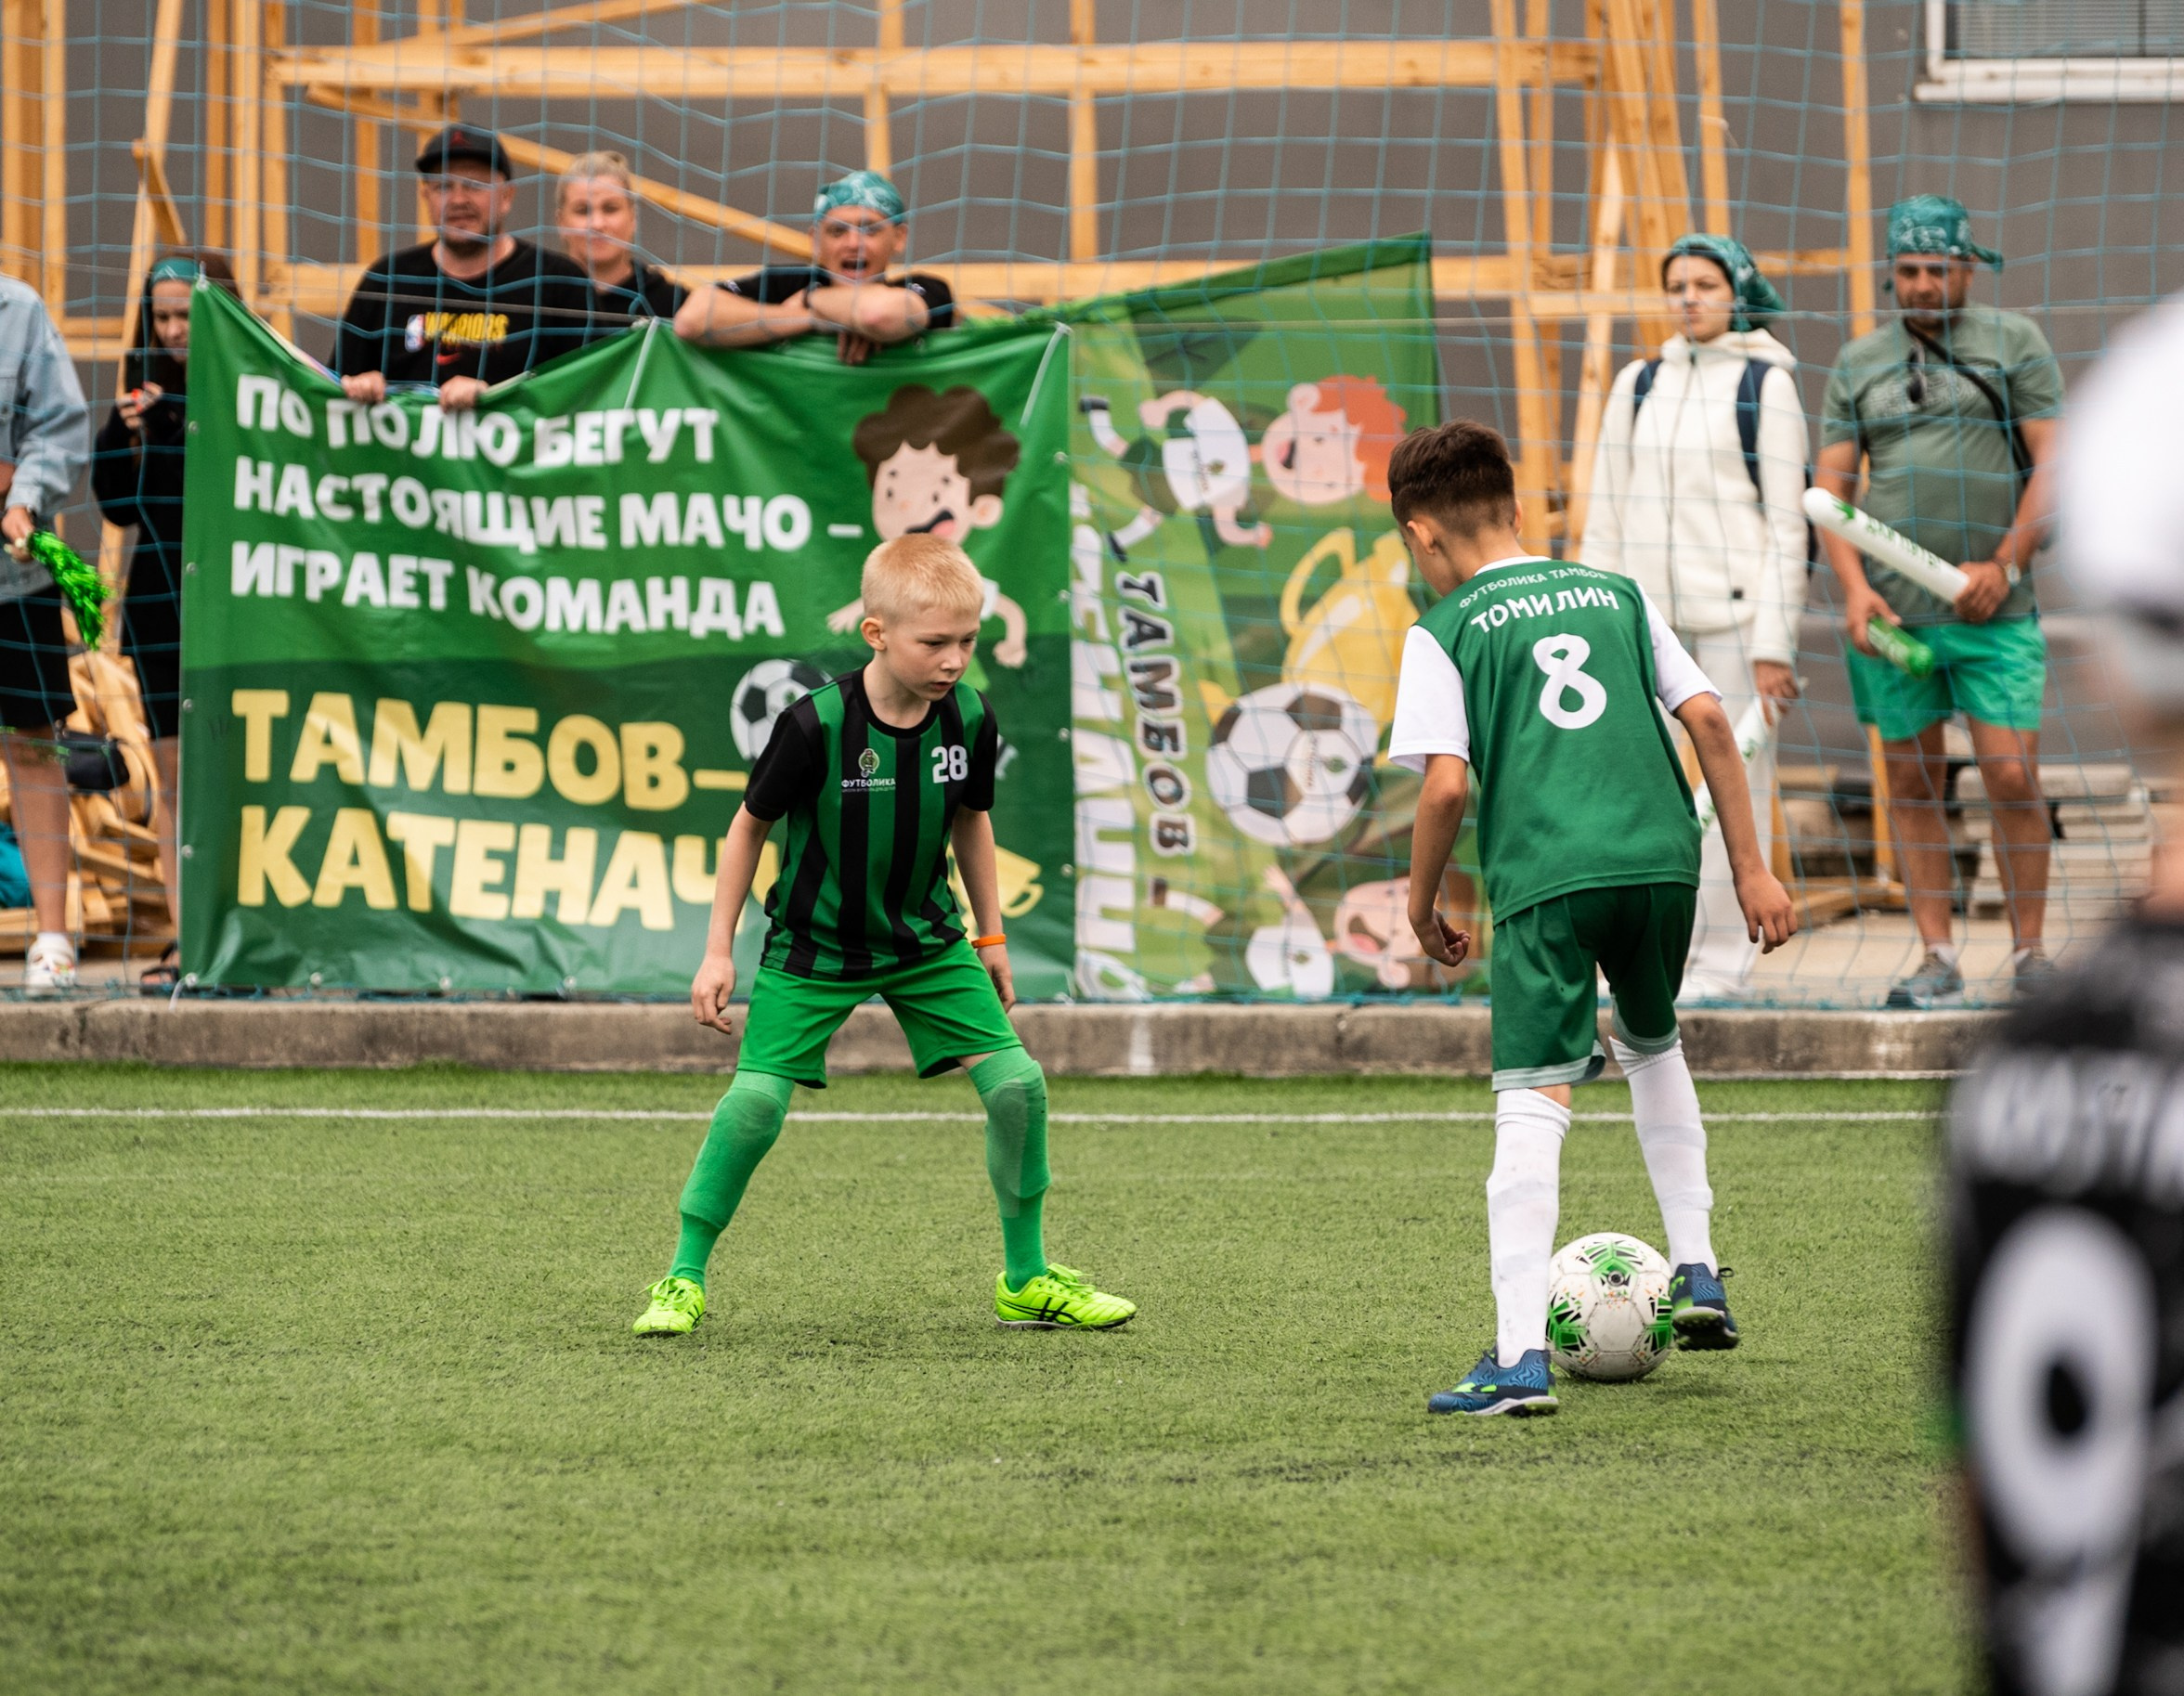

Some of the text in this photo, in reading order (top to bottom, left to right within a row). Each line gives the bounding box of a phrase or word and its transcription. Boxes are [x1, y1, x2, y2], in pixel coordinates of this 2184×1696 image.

[236, 374, 719, 467] ПО ПОЛЮ БЕГУТ
[234, 456, 605, 553] НАСТОЯЩИЕ
[619, 492, 812, 551] МАЧО
[230, 541, 786, 641] ИГРАЕТ КОМАНДА
[1459, 573, 1549, 609] ФУТБОЛИКА
[1470, 586, 1620, 634] ТОМИЛИН
[1117, 572, 1193, 856] ТАМБОВ
[1532, 633, 1607, 730] 8
[841, 778, 896, 788] ФУТБОЛИКА
[930, 744, 968, 784] 28
